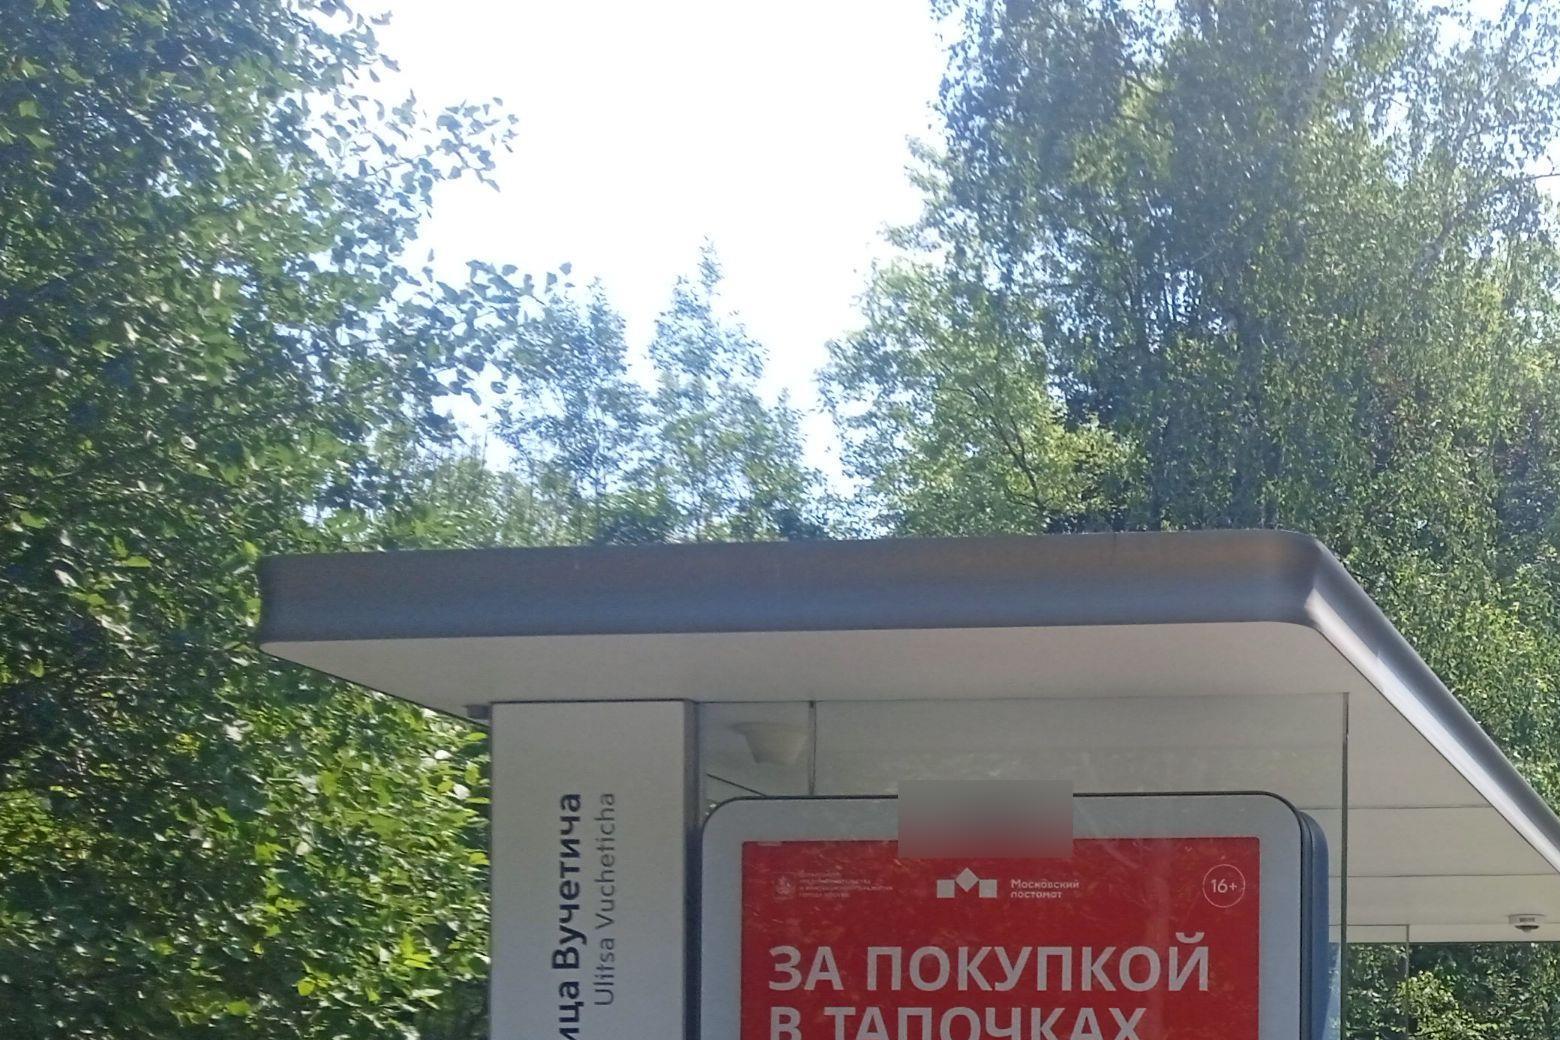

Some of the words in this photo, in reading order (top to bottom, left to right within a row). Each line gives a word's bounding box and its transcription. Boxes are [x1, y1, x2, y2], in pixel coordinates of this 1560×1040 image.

[551, 793, 587, 969] Вучетича
[594, 793, 616, 930] Vucheticha
[1010, 878, 1080, 889] Московский
[1210, 878, 1238, 894] 16+
[594, 937, 615, 1006] Ulitsa
[768, 945, 844, 992] ЗА
[866, 932, 1209, 992] ПОКУПКОЙ
